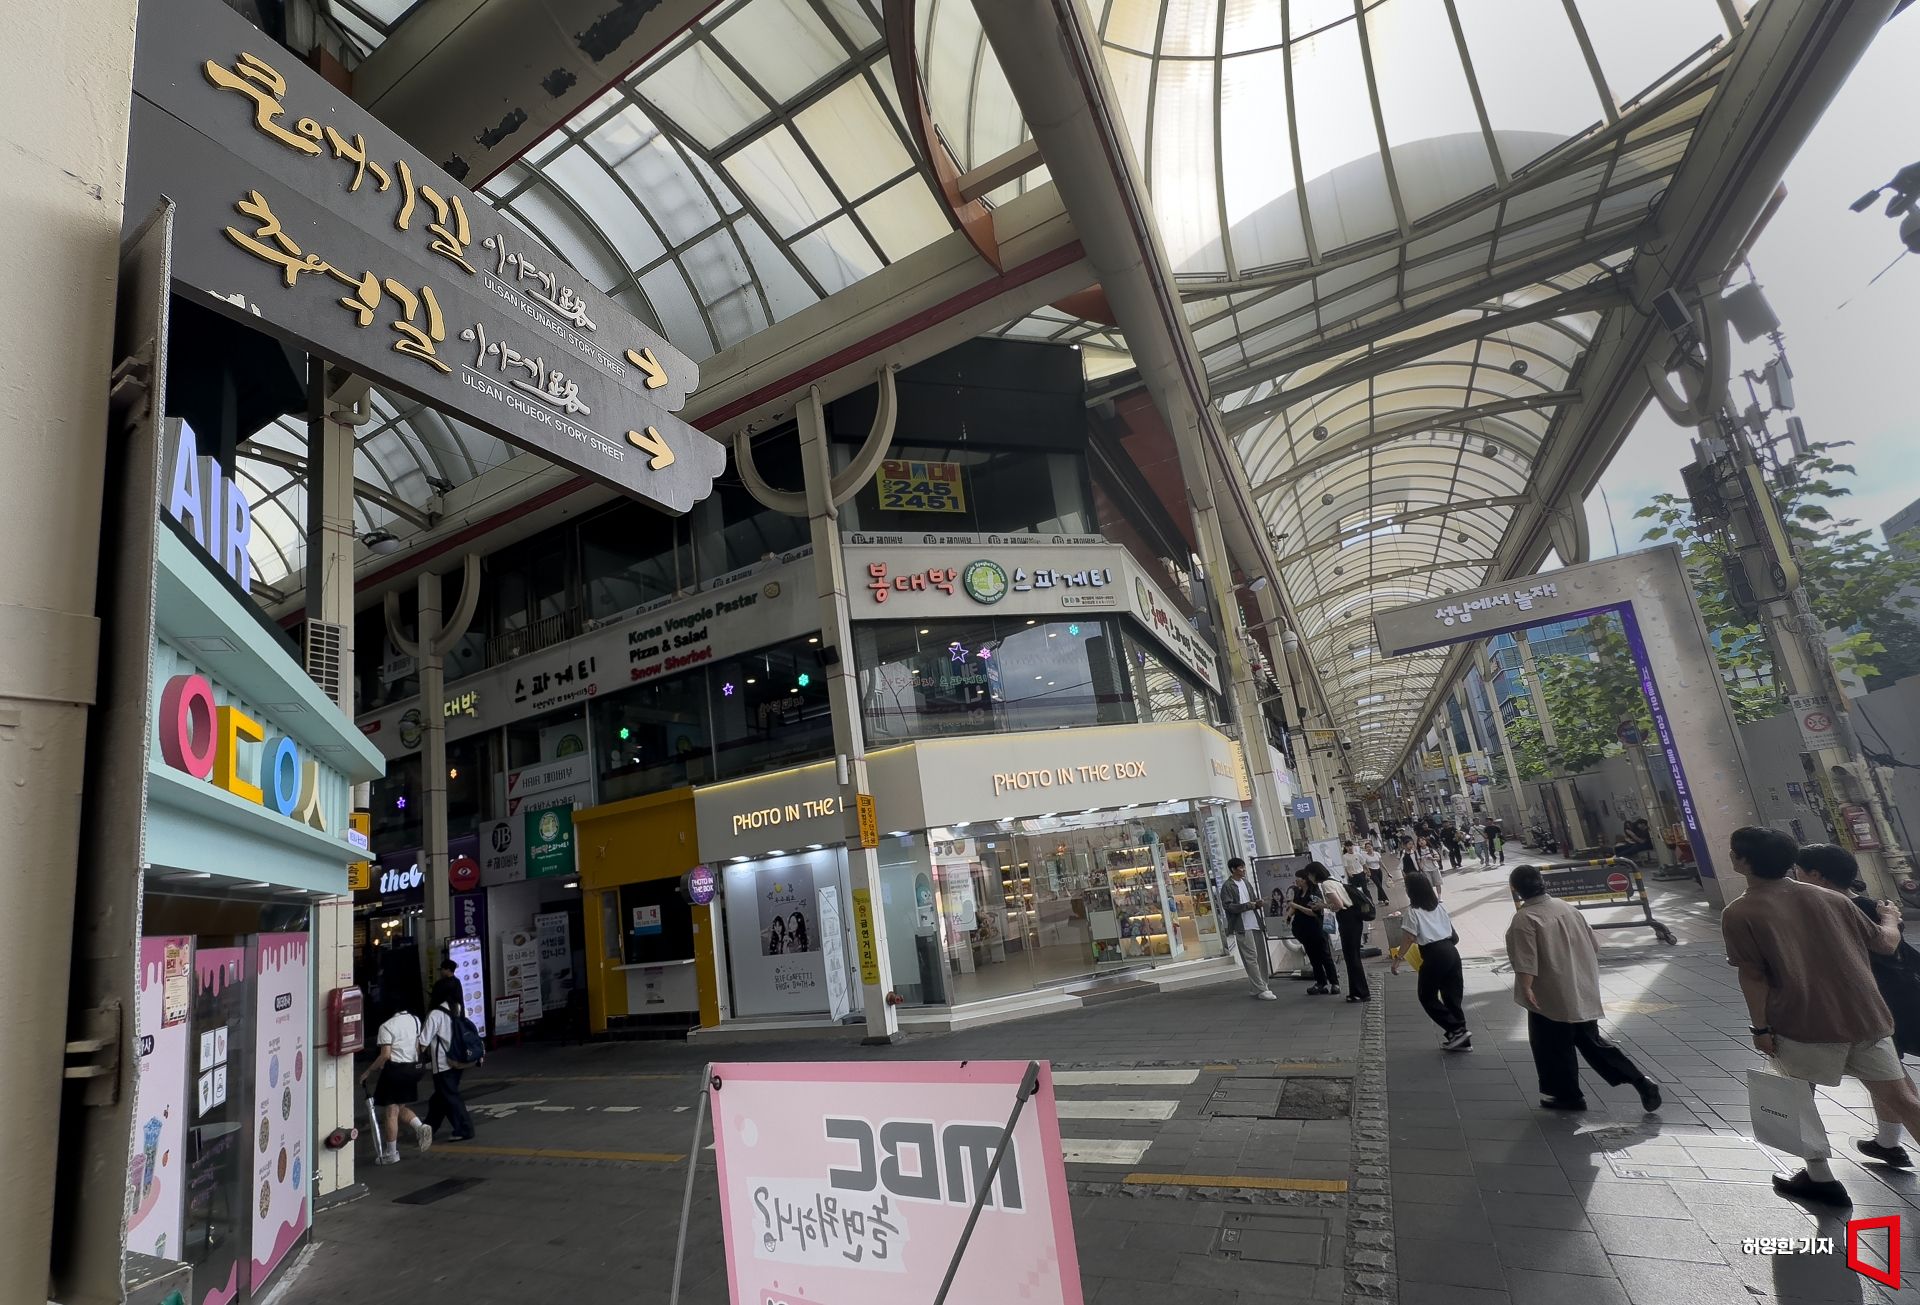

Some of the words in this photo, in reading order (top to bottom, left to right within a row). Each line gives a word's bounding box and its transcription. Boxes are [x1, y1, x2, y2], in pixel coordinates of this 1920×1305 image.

[484, 276, 518, 308] ULSAN
[520, 300, 566, 340] KEUNAEGI
[568, 333, 596, 359] STORY
[597, 353, 626, 379] STREET
[462, 371, 503, 402] ULSAN
[506, 395, 553, 427] CHUEOK
[555, 419, 588, 444] STORY
[590, 437, 625, 463] STREET
[882, 461, 957, 482] 임대
[893, 480, 952, 496] 245
[884, 493, 961, 511] 2451
[868, 562, 958, 604] 봉대박
[1014, 567, 1113, 592] 스파게티
[628, 625, 662, 645] Korea
[664, 606, 713, 632] Vongole
[715, 592, 758, 616] Pastar
[1434, 592, 1511, 626] 성남에서
[629, 644, 659, 663] Pizza
[661, 640, 672, 651] &
[673, 625, 708, 647] Salad
[515, 656, 596, 703] 스파게티
[630, 661, 662, 682] Snow
[664, 645, 713, 672] Sherbet
[993, 768, 1052, 796] PHOTO
[1057, 767, 1074, 785] IN
[1077, 762, 1111, 783] THE
[1115, 760, 1148, 780] BOX
[732, 807, 781, 836] PHOTO
[785, 804, 800, 822] IN
[803, 799, 832, 817] THE
[691, 879, 708, 887] PHOTO
[702, 884, 714, 892] BOX
[860, 919, 872, 960] 금연거리
